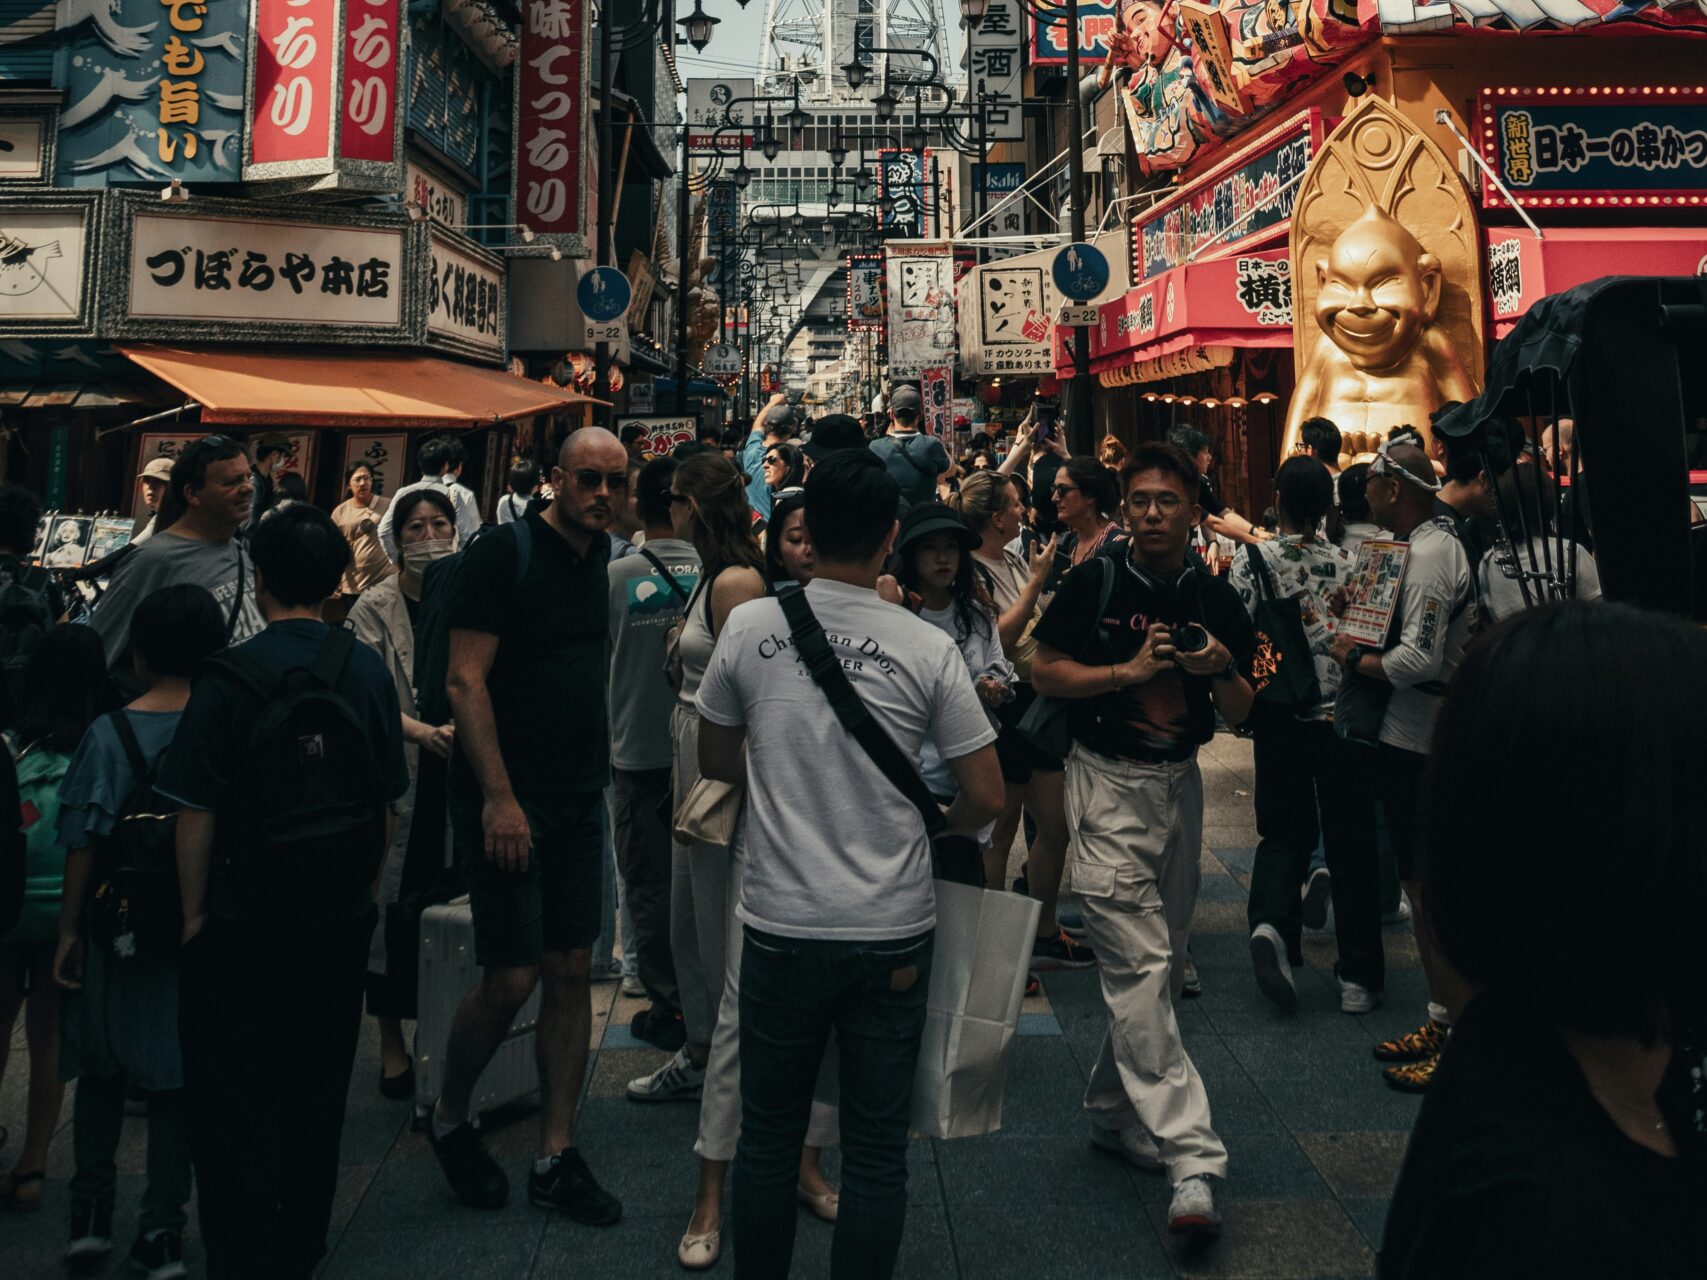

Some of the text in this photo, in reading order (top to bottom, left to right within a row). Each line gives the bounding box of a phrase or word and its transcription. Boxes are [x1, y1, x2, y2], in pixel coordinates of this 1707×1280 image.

[1505, 114, 1533, 182] 新世界
[1534, 124, 1707, 168] 日本一の串かつ
[145, 244, 391, 299] づぼらや本店
[1239, 273, 1293, 309] 横
[1490, 256, 1521, 299] 横綱
[984, 349, 993, 358] 1F
[984, 361, 993, 370] 2F
[650, 564, 700, 576] CLORA
[757, 625, 852, 660] Chran
[857, 635, 897, 677] Dior
